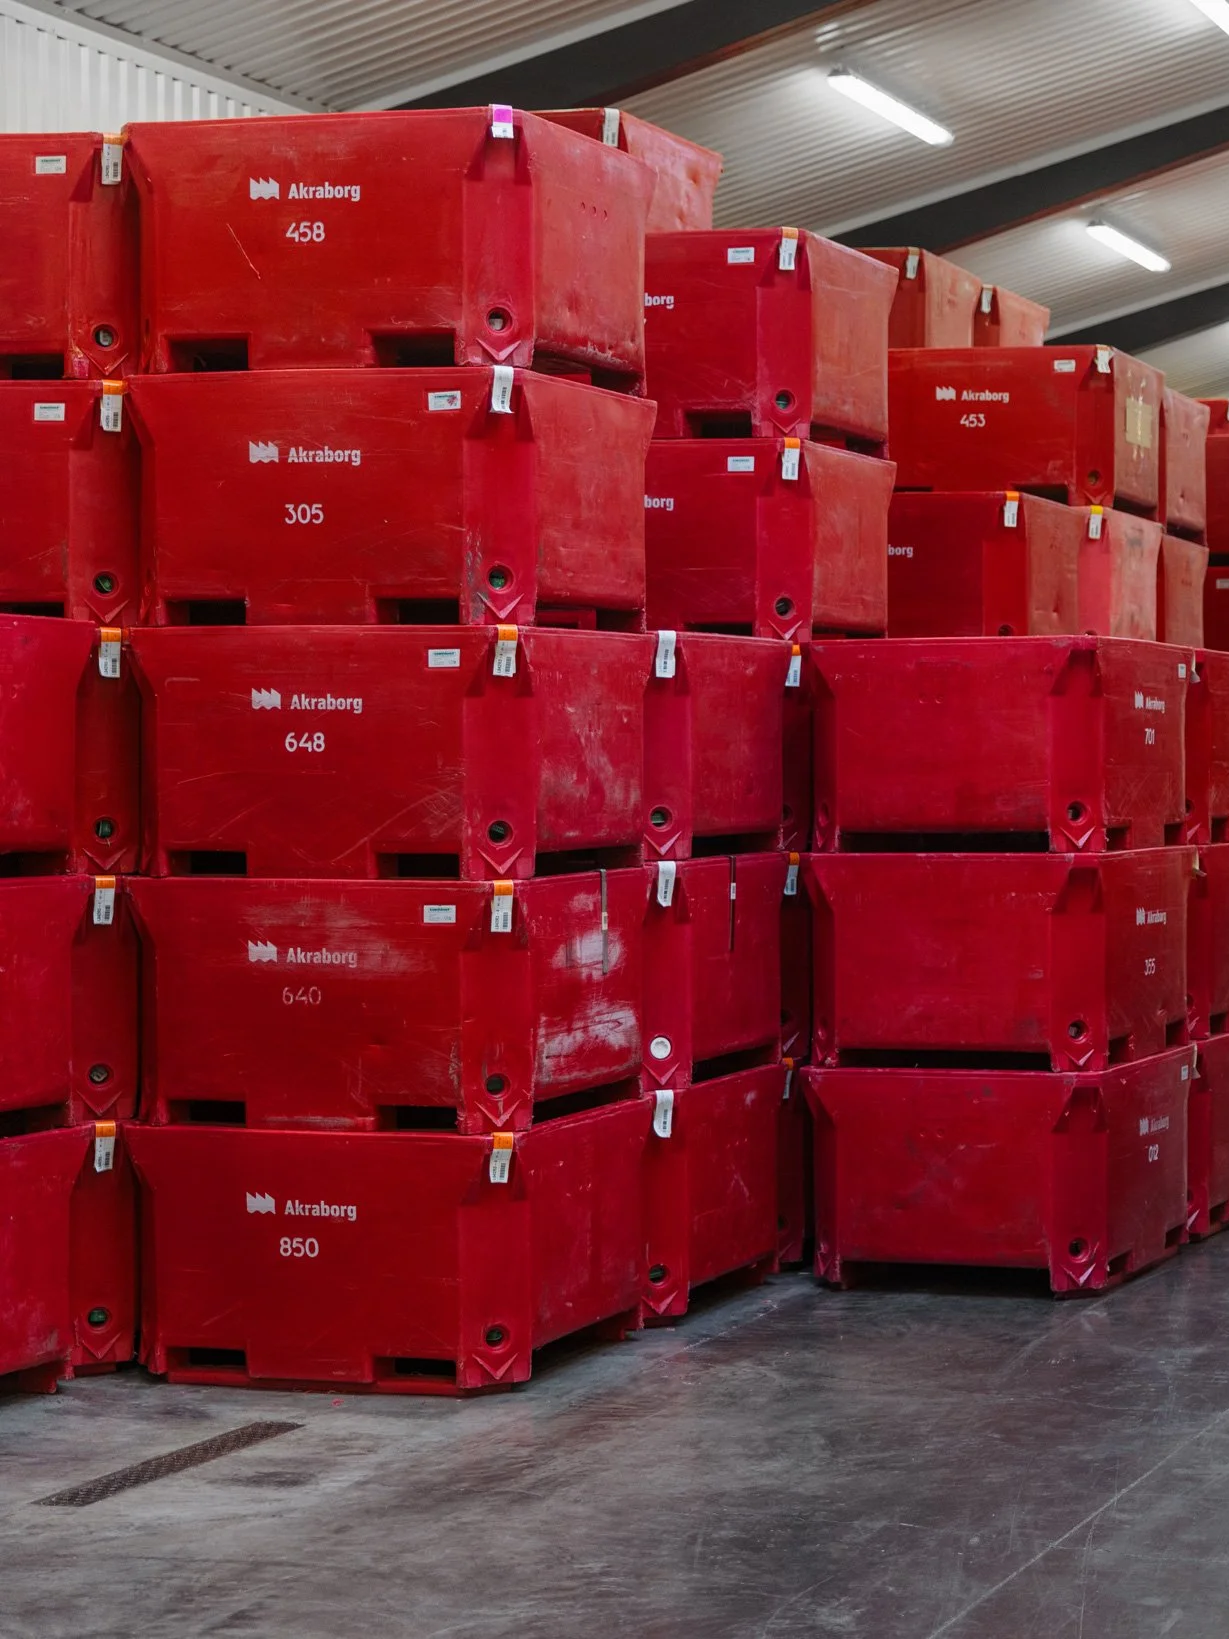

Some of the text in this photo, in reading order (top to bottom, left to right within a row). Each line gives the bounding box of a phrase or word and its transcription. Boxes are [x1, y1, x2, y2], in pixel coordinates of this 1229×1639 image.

[287, 181, 361, 202] Akraborg
[285, 221, 326, 243] 458
[645, 292, 675, 310] borg
[961, 389, 1010, 404] Akraborg
[959, 413, 986, 428] 453
[287, 445, 361, 467] Akraborg
[645, 494, 675, 512] borg
[284, 503, 324, 525] 305
[888, 543, 914, 558] borg
[290, 693, 363, 714] Akraborg
[284, 732, 326, 753] 648
[286, 947, 358, 969] Akraborg
[282, 986, 322, 1005] 640
[284, 1199, 357, 1222] Akraborg
[279, 1236, 320, 1258] 850
